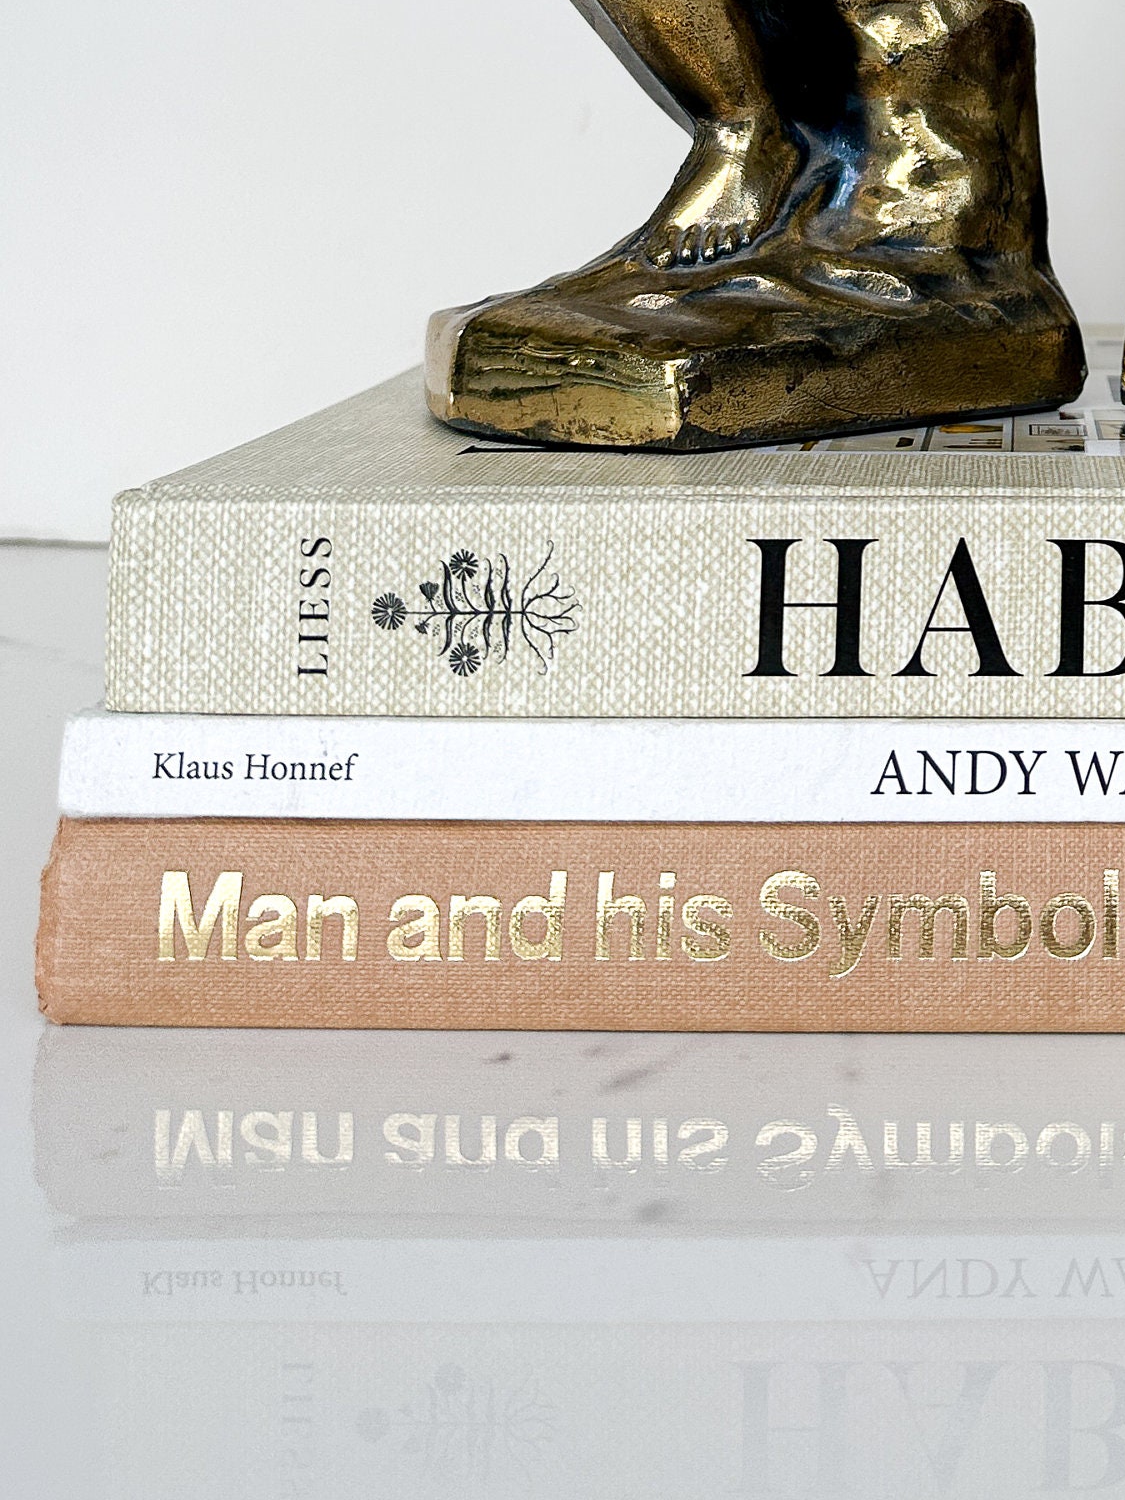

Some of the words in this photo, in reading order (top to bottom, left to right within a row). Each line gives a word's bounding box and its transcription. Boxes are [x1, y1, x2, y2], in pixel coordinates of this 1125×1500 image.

[297, 536, 333, 678] LIESS
[152, 752, 234, 781] Klaus
[243, 752, 360, 781] Honnef
[870, 750, 1047, 795] ANDY
[155, 869, 361, 962] Man
[386, 869, 568, 962] and
[594, 871, 733, 962] his
